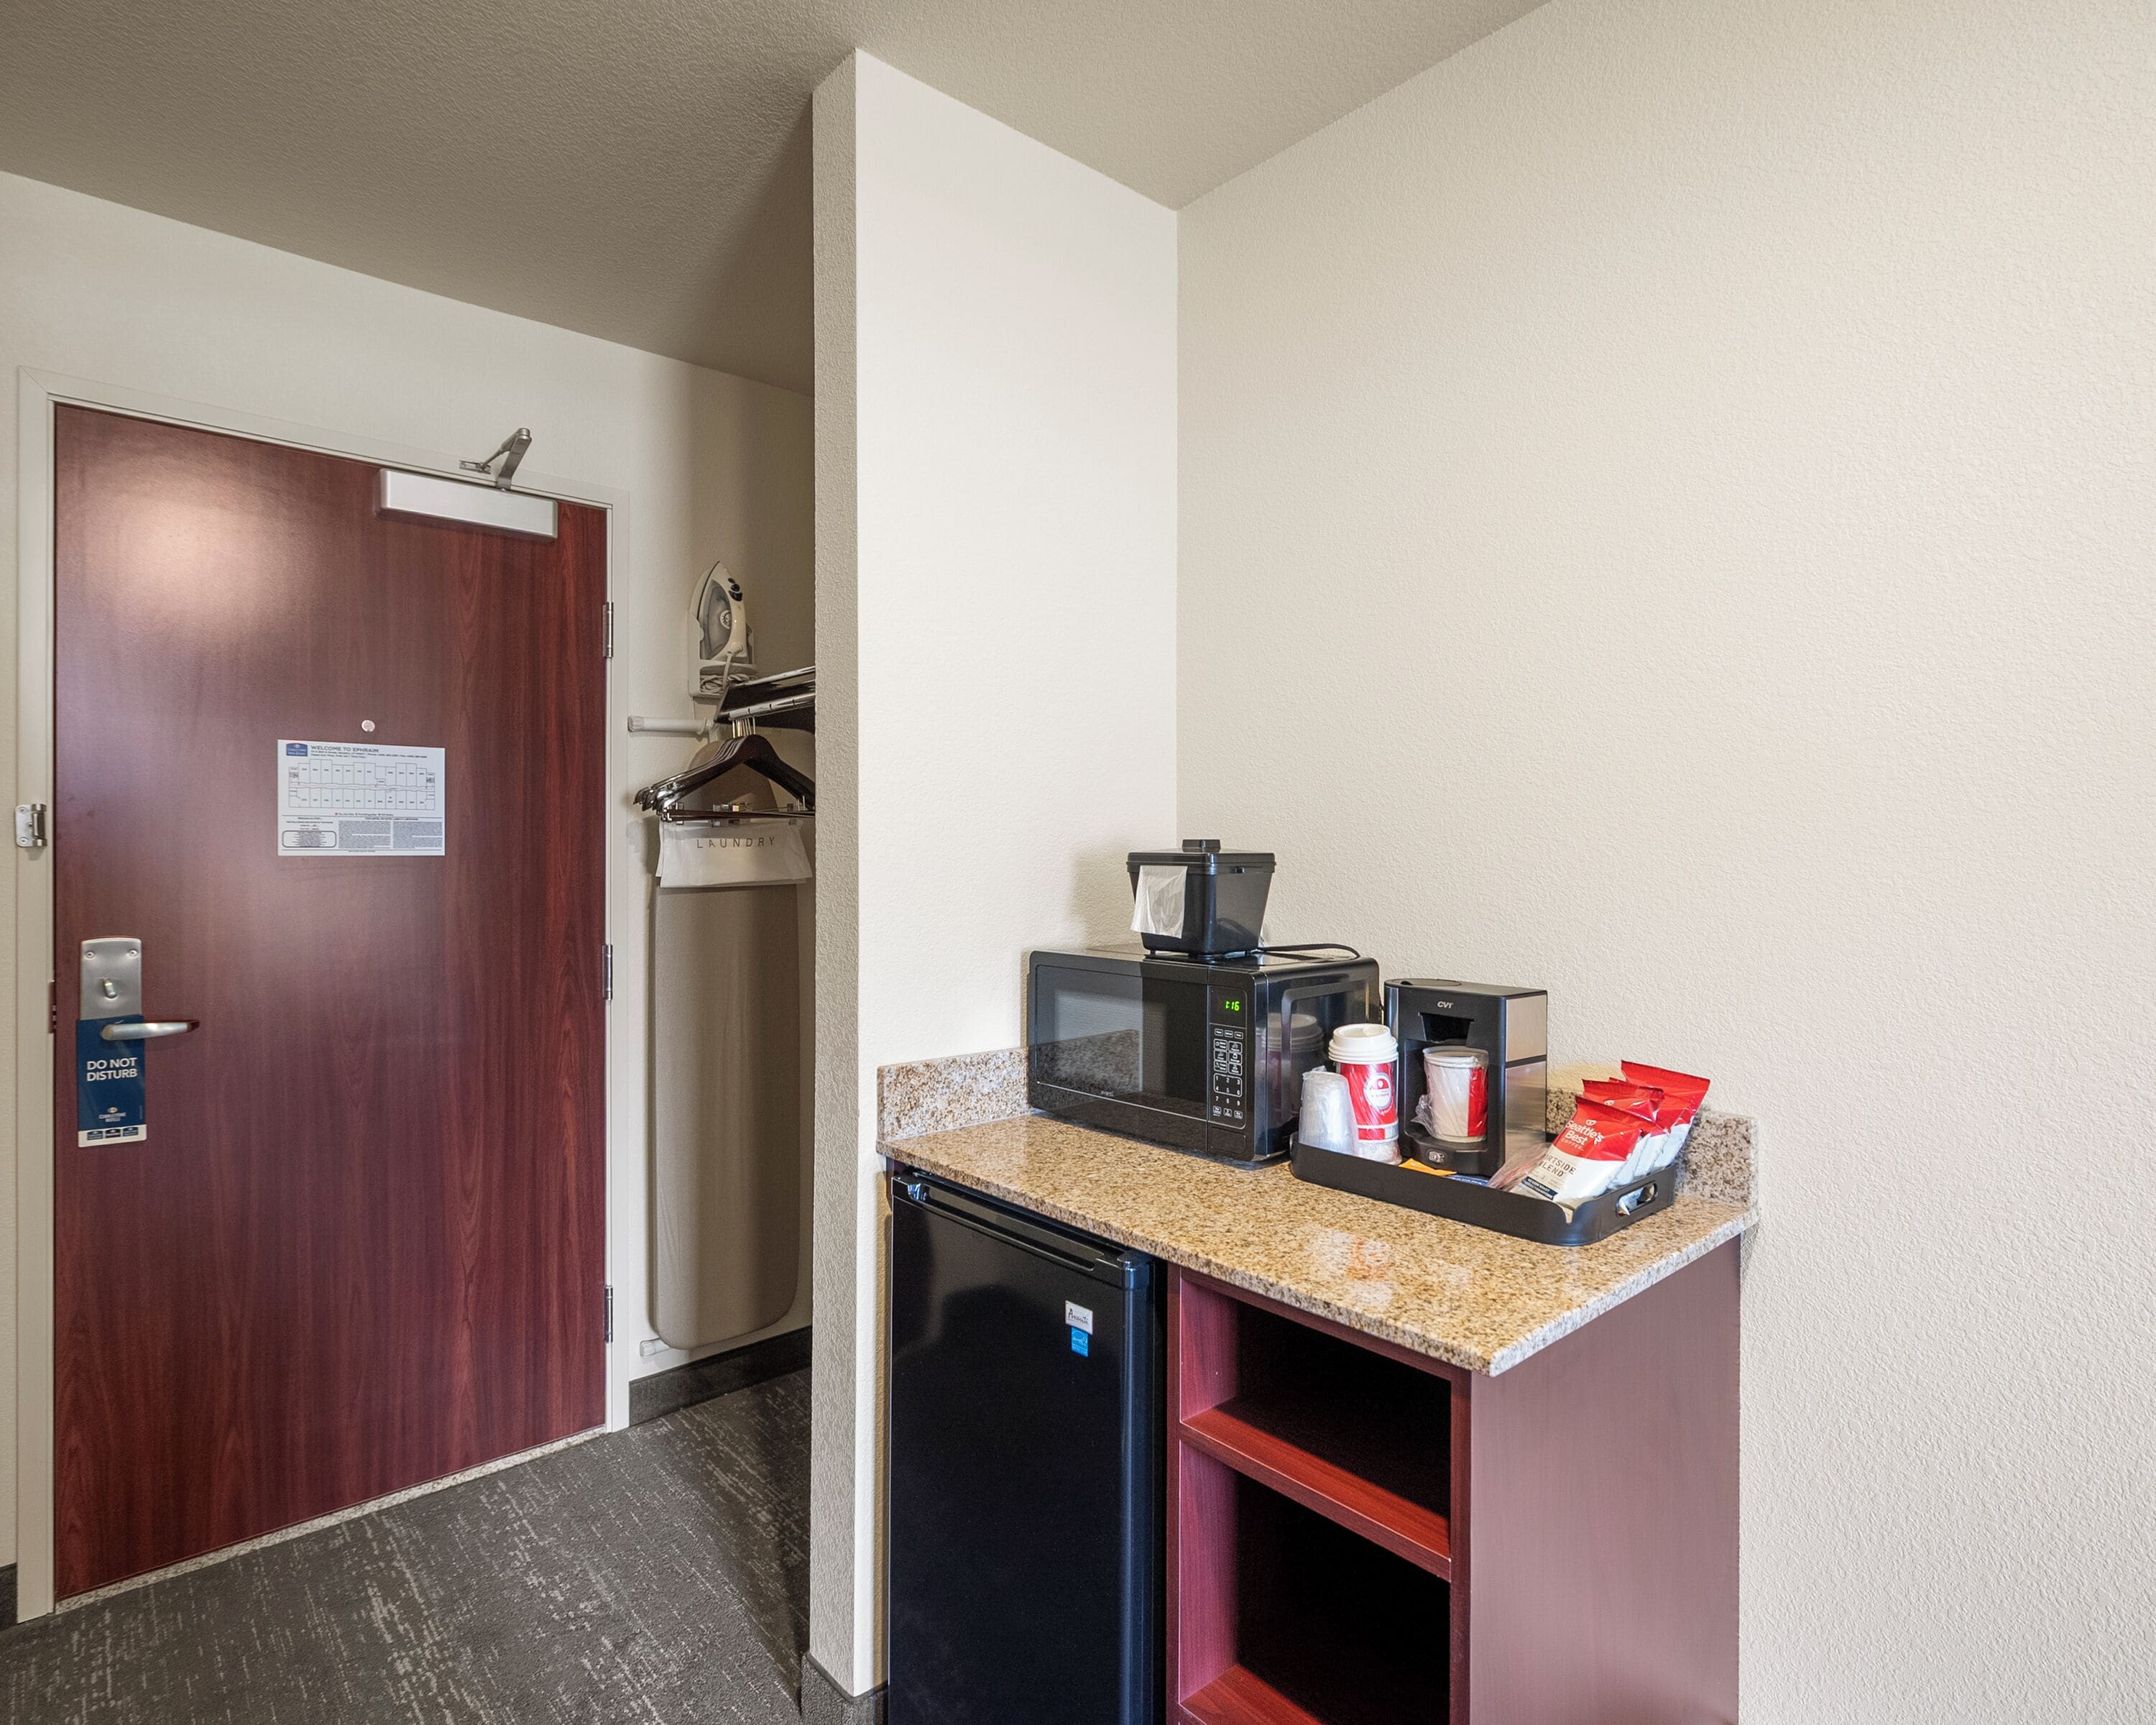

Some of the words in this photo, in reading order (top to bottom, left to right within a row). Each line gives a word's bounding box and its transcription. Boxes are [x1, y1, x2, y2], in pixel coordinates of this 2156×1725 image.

[696, 836, 775, 849] LAUNDRY
[86, 1059, 107, 1070] DO
[109, 1057, 138, 1069] NOT
[86, 1068, 138, 1082] DISTURB
[1565, 1130, 1588, 1146] Best
[1566, 1120, 1604, 1144] Seattle's
[1542, 1161, 1564, 1177] LEND
[1545, 1154, 1577, 1174] RTSIDE
